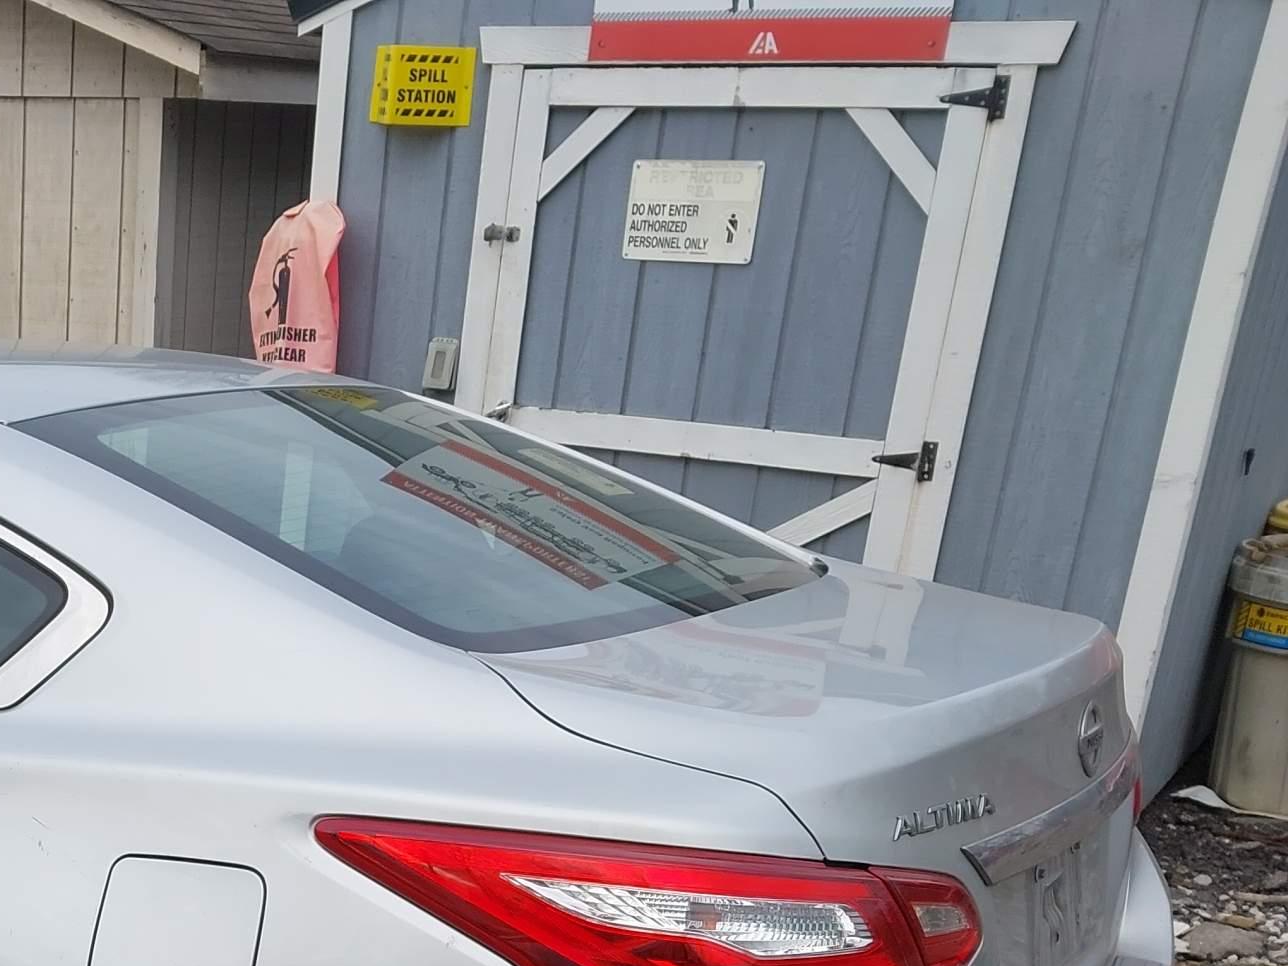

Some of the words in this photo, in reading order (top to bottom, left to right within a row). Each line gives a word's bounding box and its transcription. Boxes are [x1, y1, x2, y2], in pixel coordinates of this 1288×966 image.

[409, 68, 449, 83] SPILL
[396, 88, 456, 104] STATION
[631, 203, 646, 216] DO
[647, 203, 667, 217] NOT
[668, 204, 700, 217] ENTER
[629, 219, 688, 233] AUTHORIZED
[627, 235, 682, 249] PERSONNEL
[683, 237, 710, 250] ONLY
[1276, 624, 1288, 635] KI
[893, 793, 996, 842] ALTIMA
